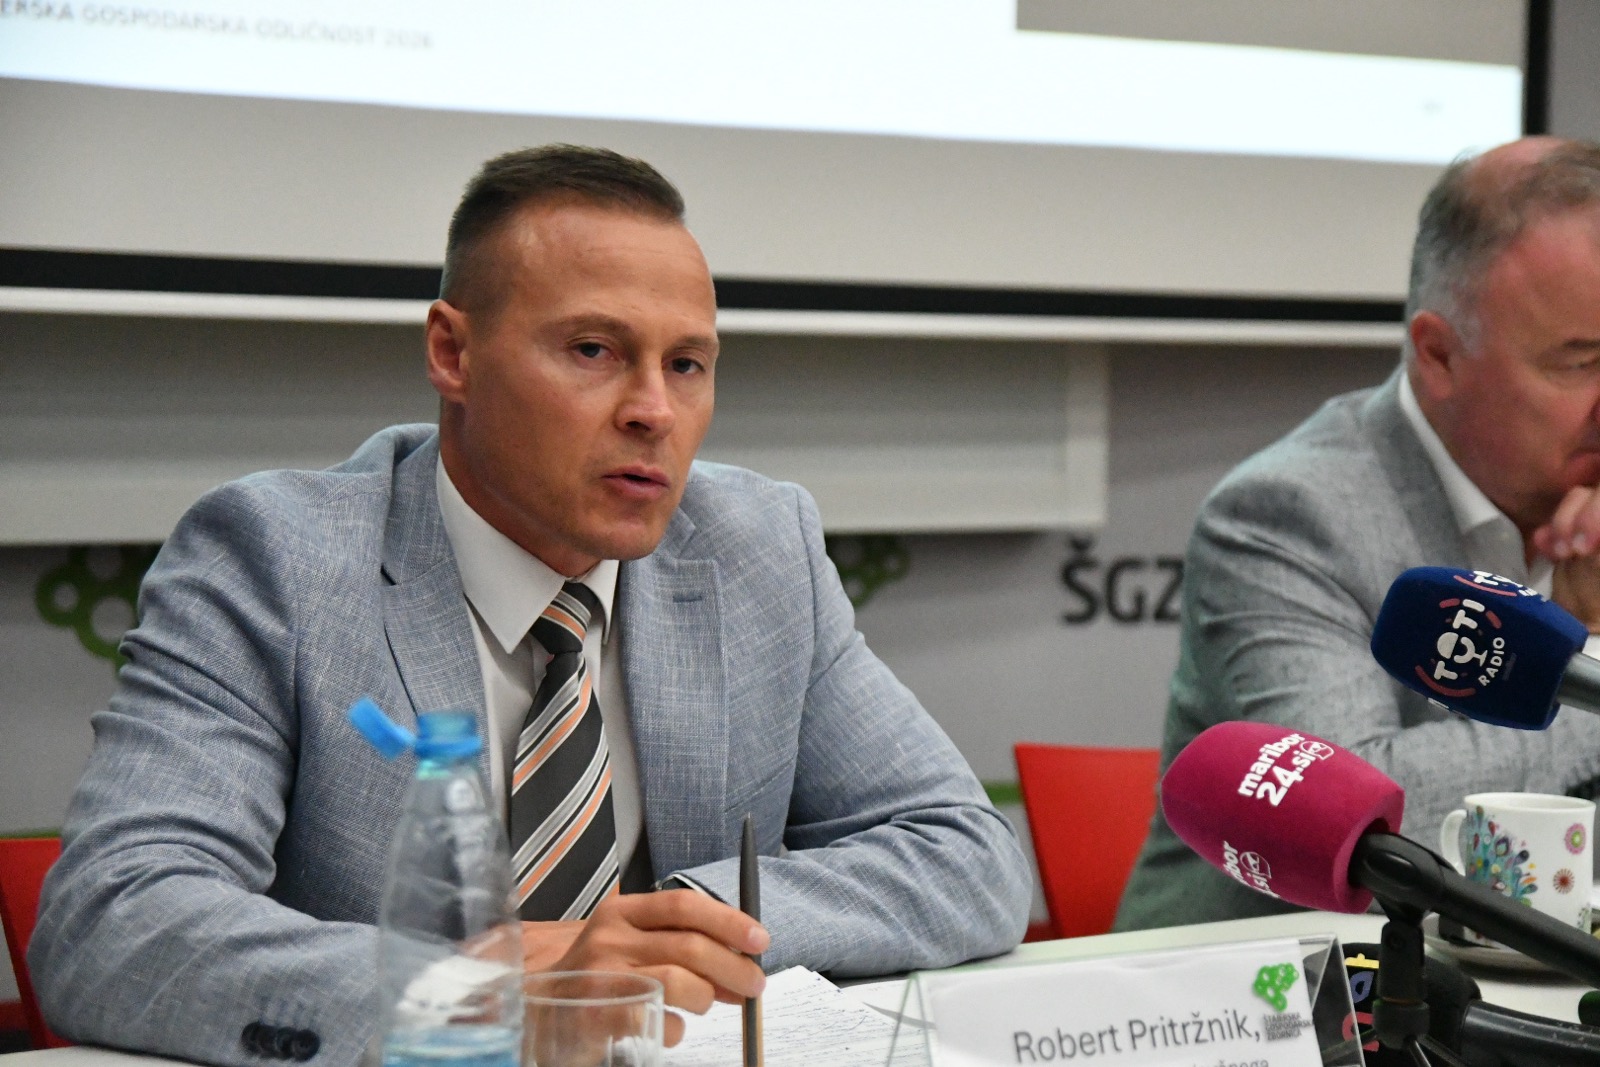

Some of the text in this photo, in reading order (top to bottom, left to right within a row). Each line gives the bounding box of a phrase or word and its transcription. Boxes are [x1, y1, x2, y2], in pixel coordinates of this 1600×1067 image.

[81, 3, 248, 36] GOSPODARSKA
[255, 16, 376, 46] ODLIČNOST
[1058, 535, 1185, 625] ŠGZ
[1477, 636, 1506, 687] RADIO
[1237, 732, 1305, 797] maribor
[1255, 749, 1316, 807] 24.si
[1013, 1008, 1261, 1064] Robert Pritržnik,
